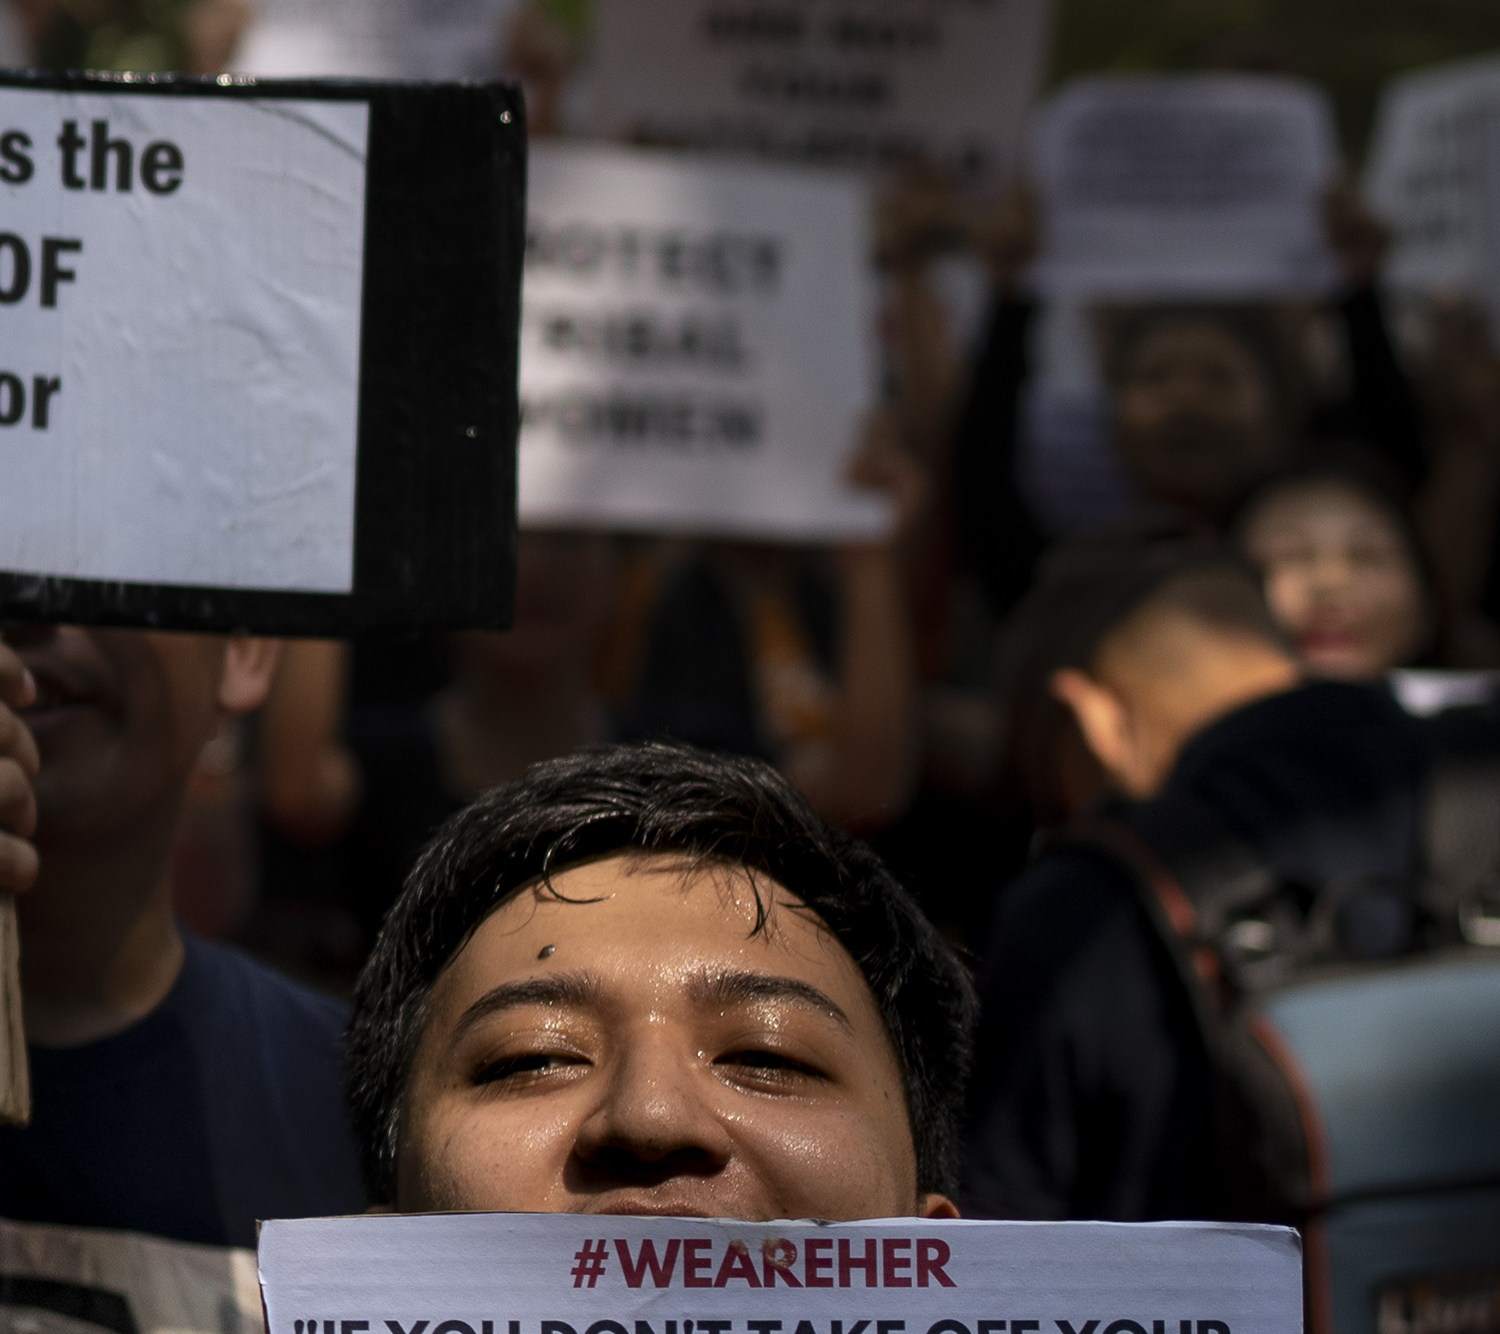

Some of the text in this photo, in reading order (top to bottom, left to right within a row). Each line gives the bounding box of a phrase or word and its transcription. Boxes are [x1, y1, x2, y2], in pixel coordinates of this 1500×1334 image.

[55, 118, 185, 197] the
[518, 392, 765, 458] OMEN
[570, 1236, 957, 1290] #WEAREHER
